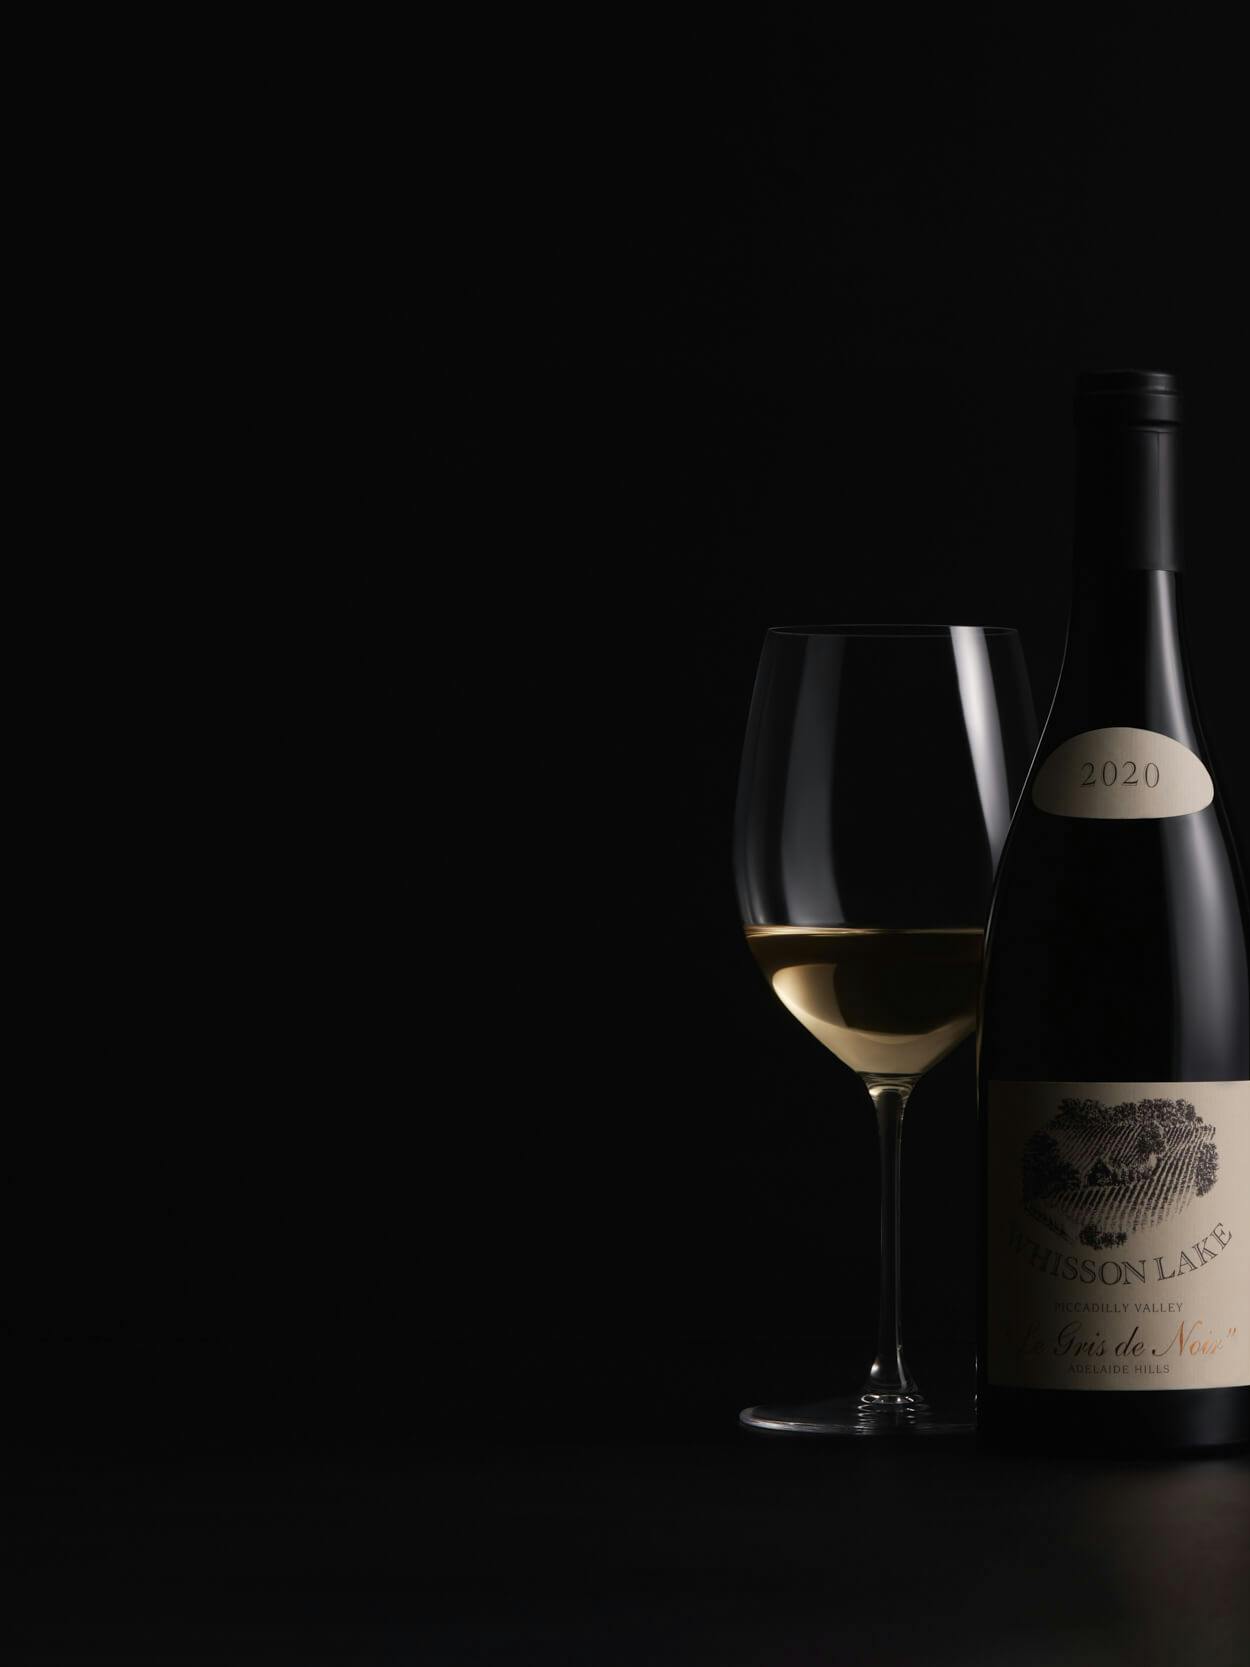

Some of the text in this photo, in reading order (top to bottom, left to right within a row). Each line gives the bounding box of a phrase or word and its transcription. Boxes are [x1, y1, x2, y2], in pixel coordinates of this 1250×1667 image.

[1079, 760, 1160, 788] 2020
[1153, 1222, 1234, 1282] LAKE
[1053, 1302, 1184, 1313] PICCADILLY VALLEY
[1053, 1320, 1106, 1357] Gris
[1114, 1325, 1145, 1357] de
[1067, 1364, 1170, 1375] ADELAIDE HILLS
